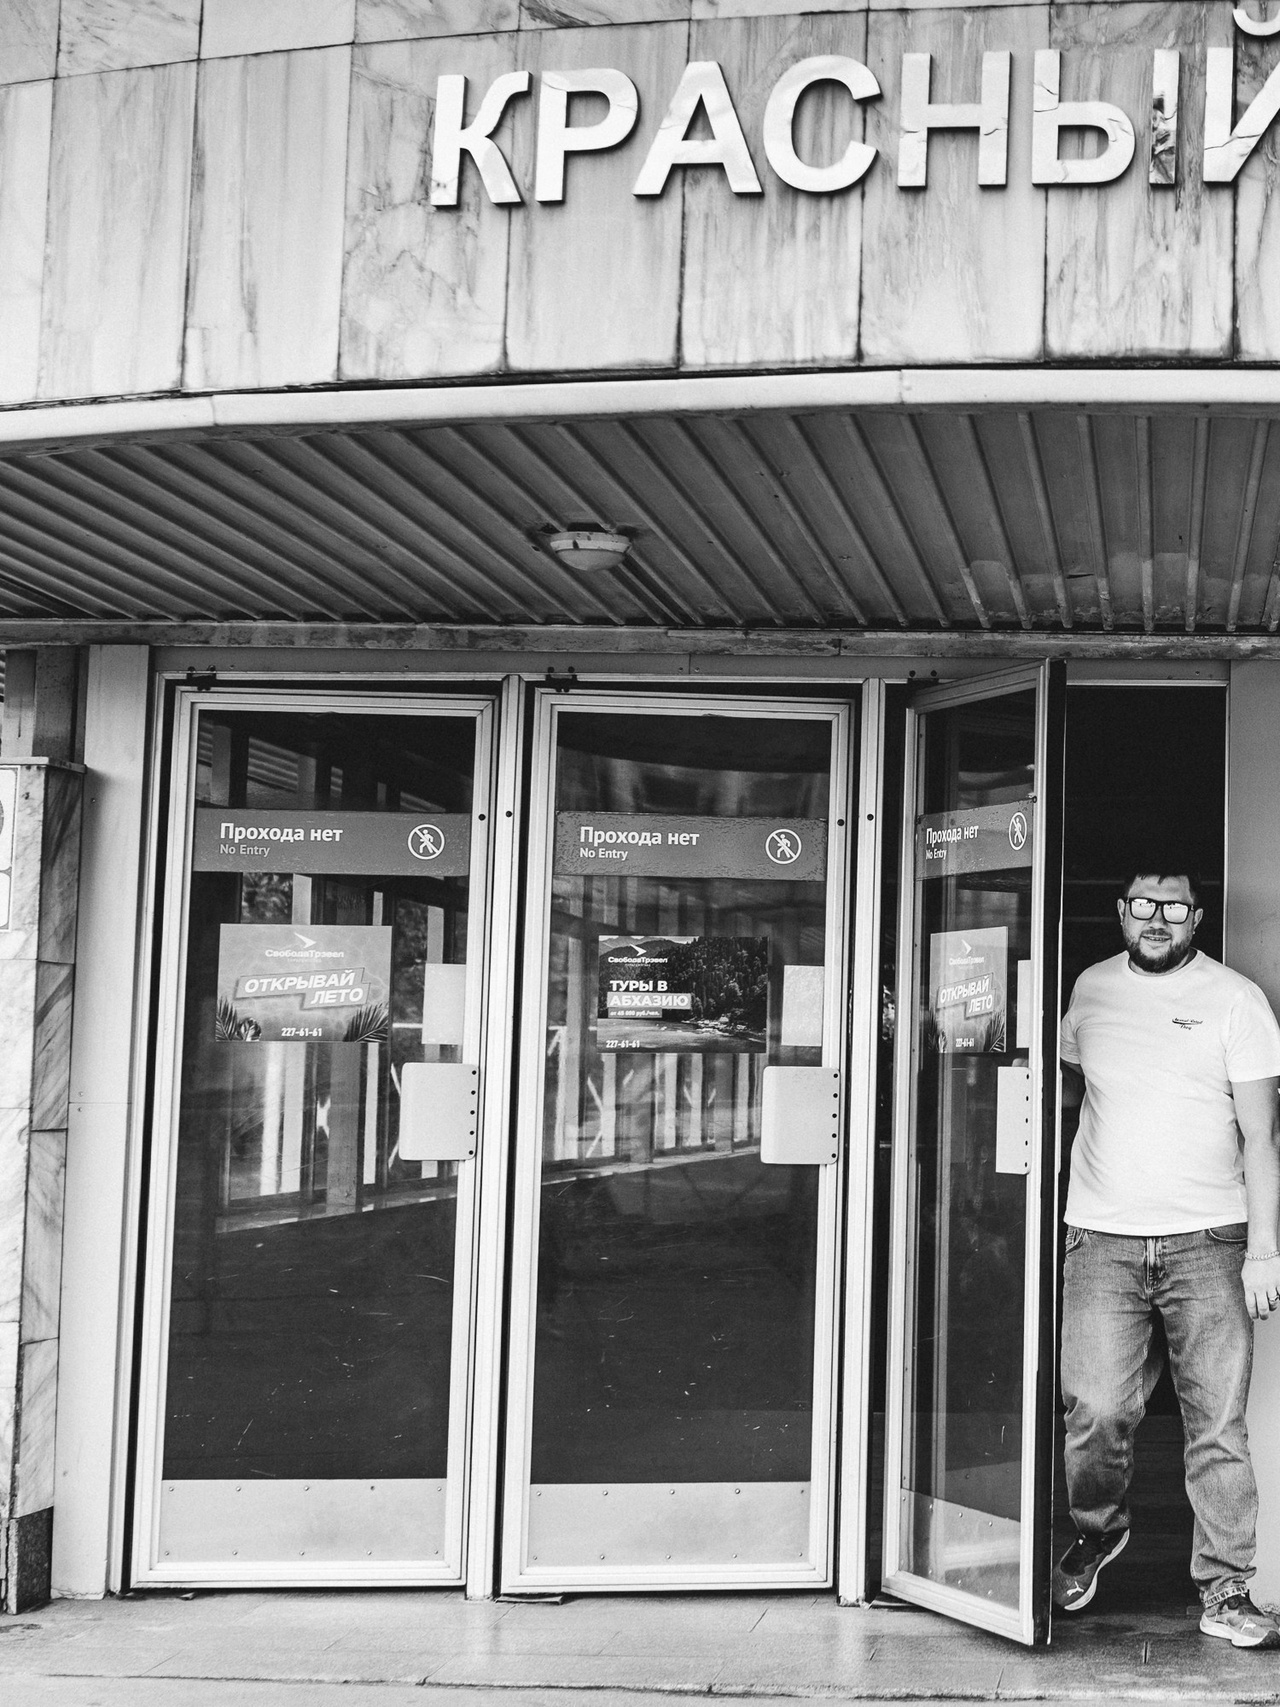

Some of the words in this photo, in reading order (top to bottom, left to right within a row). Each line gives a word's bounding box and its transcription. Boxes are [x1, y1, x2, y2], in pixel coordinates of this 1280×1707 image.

[220, 822, 304, 843] Прохода
[310, 828, 343, 841] нет
[580, 826, 662, 847] Прохода
[667, 832, 700, 845] нет
[926, 827, 961, 848] Прохода
[963, 825, 979, 840] нет
[220, 844, 236, 854] No
[240, 844, 270, 857] Entry
[579, 847, 596, 858] No
[598, 848, 628, 861] Entry
[934, 848, 947, 860] Entry
[265, 950, 345, 959] СвободаТрэвел
[607, 956, 668, 964] СвободаТрэвел
[244, 970, 355, 993] ОТКРЫВАЙ
[609, 980, 653, 991] ТУРЫ
[657, 980, 668, 991] В
[311, 988, 364, 1004] ЛЕТО
[940, 975, 990, 1004] ОТКРЫВАЙ
[610, 995, 689, 1006] АБХАЗИЮ
[968, 994, 993, 1013] ЛЕТО
[281, 1028, 322, 1037] 227-61-61
[605, 1040, 640, 1048] 227-61-61
